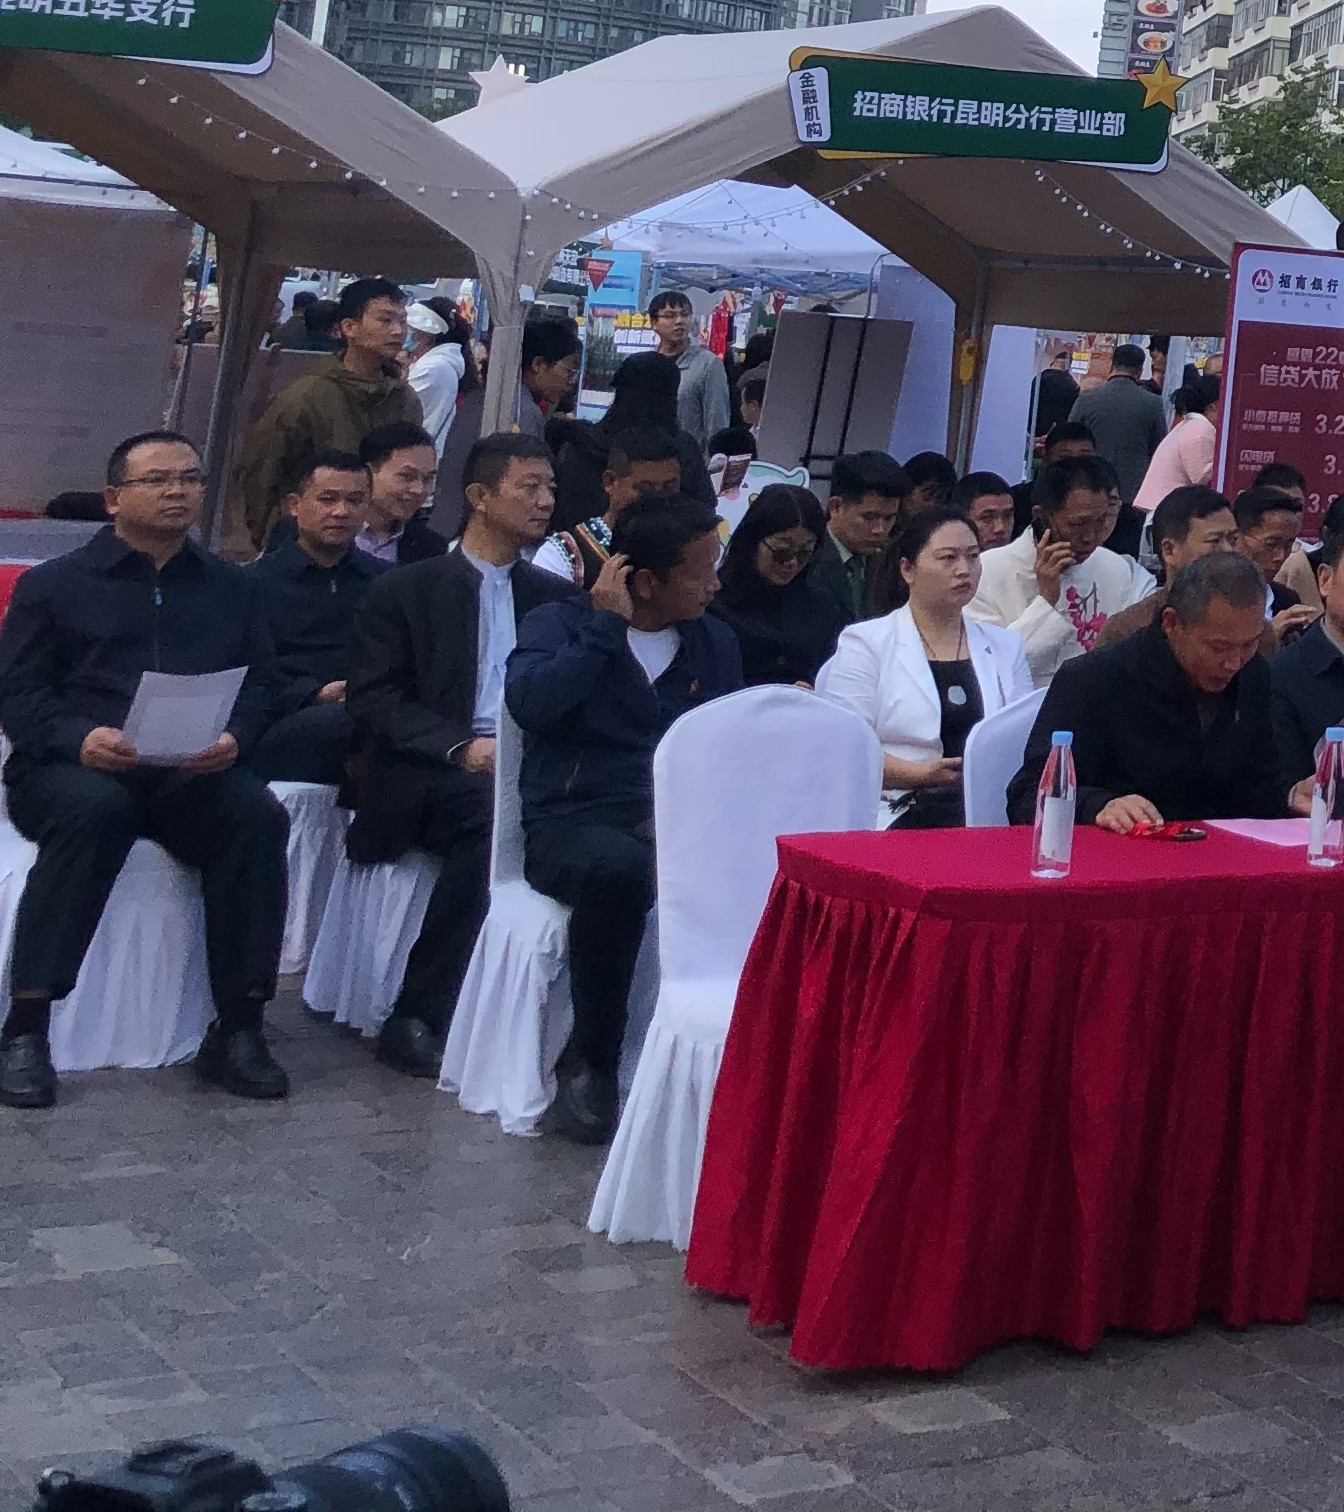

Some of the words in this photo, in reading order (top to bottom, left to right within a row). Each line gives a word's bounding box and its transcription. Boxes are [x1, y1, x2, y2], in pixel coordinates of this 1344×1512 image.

[799, 72, 823, 138] 金融机构
[852, 90, 1126, 137] 招商银行昆明分行营业部
[1278, 272, 1339, 293] 招商银行
